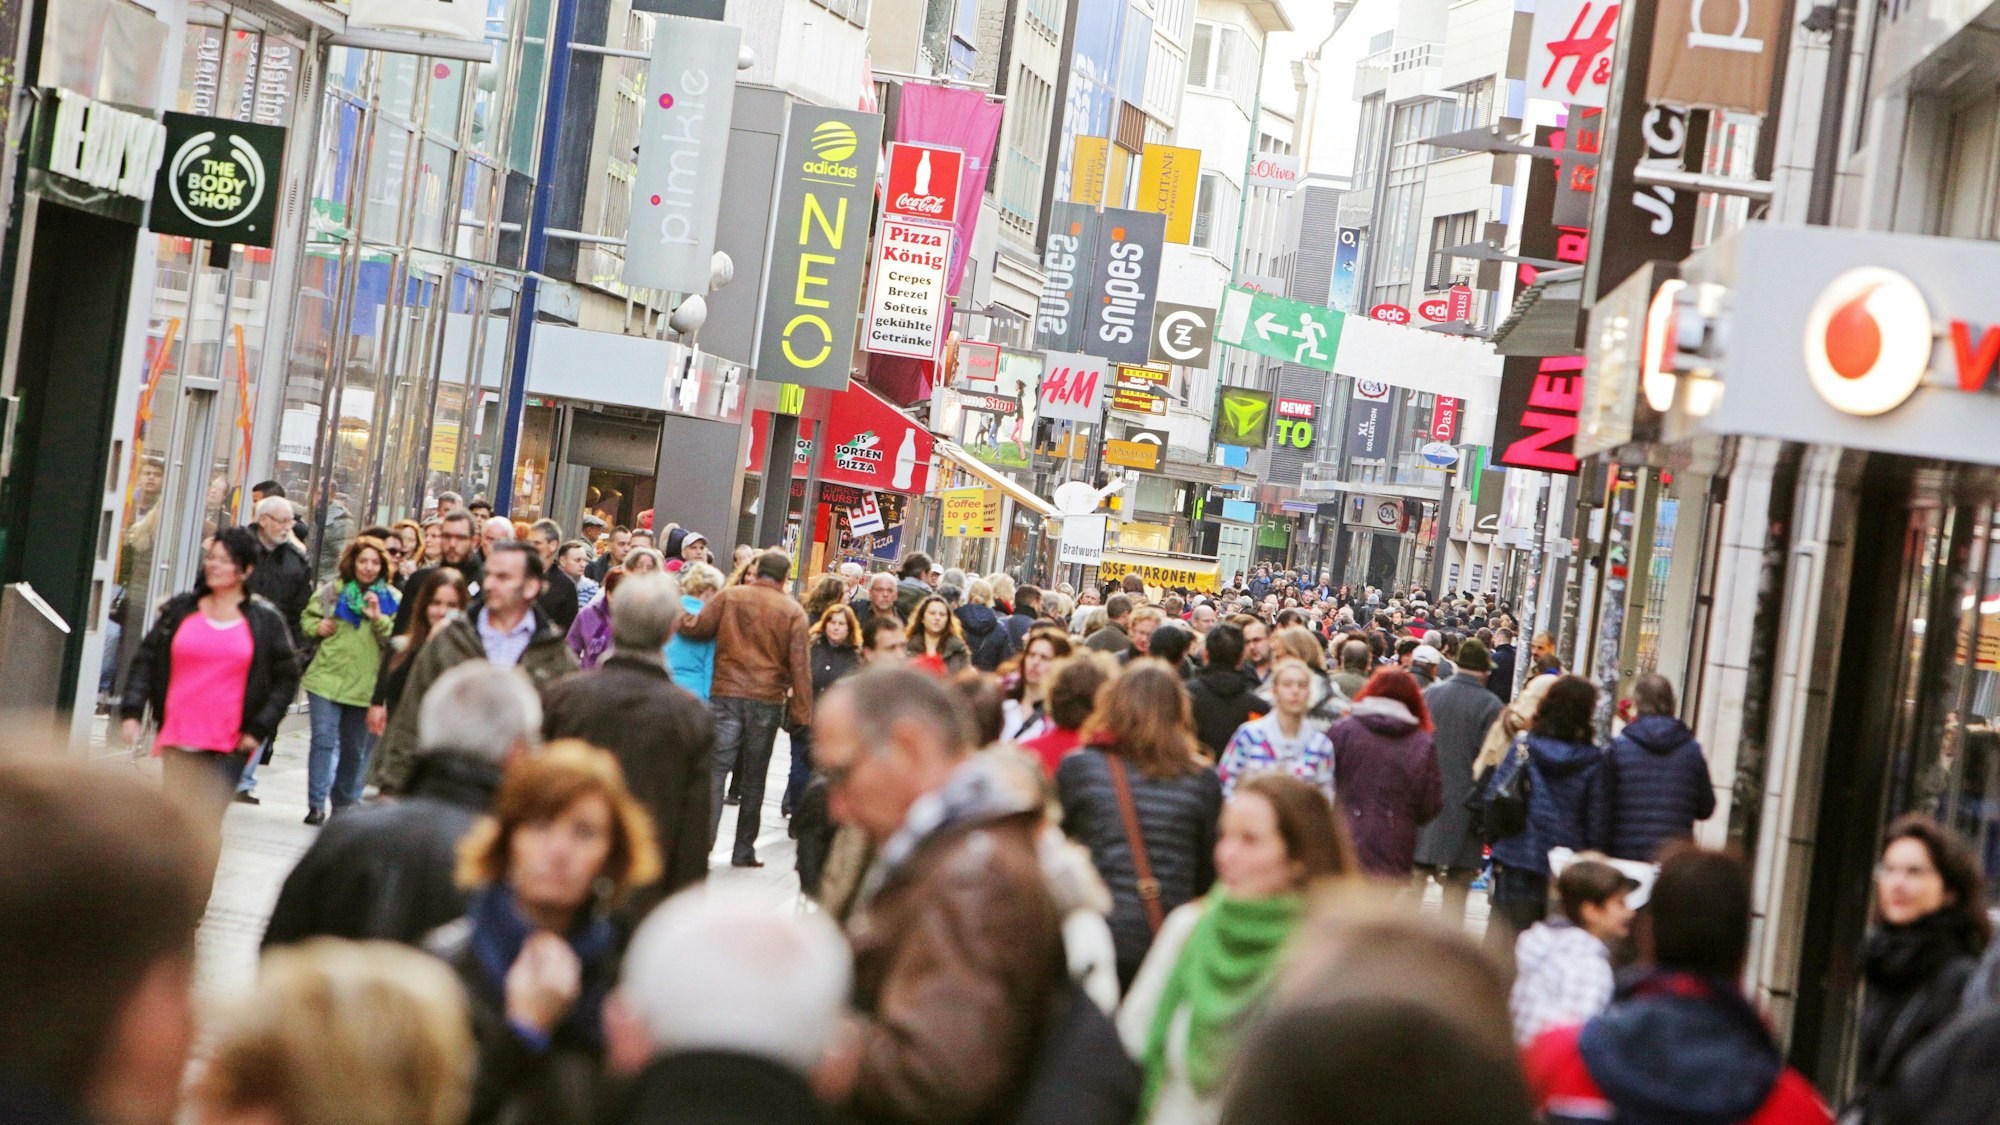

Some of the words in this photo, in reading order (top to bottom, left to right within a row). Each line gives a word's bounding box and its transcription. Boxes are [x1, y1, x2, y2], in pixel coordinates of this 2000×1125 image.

[651, 67, 710, 246] pimkie
[202, 159, 235, 177] THE
[803, 161, 858, 179] adidas
[1249, 159, 1296, 182] s.Oliver
[187, 173, 247, 196] BODY
[188, 191, 242, 211] SHOP
[895, 192, 946, 214] Coca-Cola
[889, 226, 942, 247] Pizza
[883, 246, 944, 271] König
[781, 192, 848, 369] NEO
[888, 271, 932, 286] Crepes
[888, 286, 929, 301] Brezel
[1099, 241, 1146, 344] snipes
[884, 301, 928, 316] Softeis
[1377, 309, 1405, 322] edc
[875, 317, 932, 332] gekühlte
[871, 330, 932, 347] Getränke
[1041, 367, 1100, 409] H&M
[1362, 379, 1382, 393] C&A
[1280, 401, 1312, 416] REWE
[1358, 421, 1369, 437] XL
[1366, 407, 1378, 453] KOLLEKTION
[1437, 410, 1454, 437] Das
[856, 435, 867, 443] 15
[1276, 419, 1313, 448] TO
[836, 445, 882, 460] SORTEN
[838, 459, 875, 473] PIZZA
[822, 492, 859, 504] WURST
[947, 500, 981, 508] Coffee
[947, 510, 959, 519] to
[963, 511, 978, 520] go
[872, 535, 893, 549] izza
[1062, 543, 1100, 558] Bratwurst
[1132, 565, 1197, 585] MARONEN
